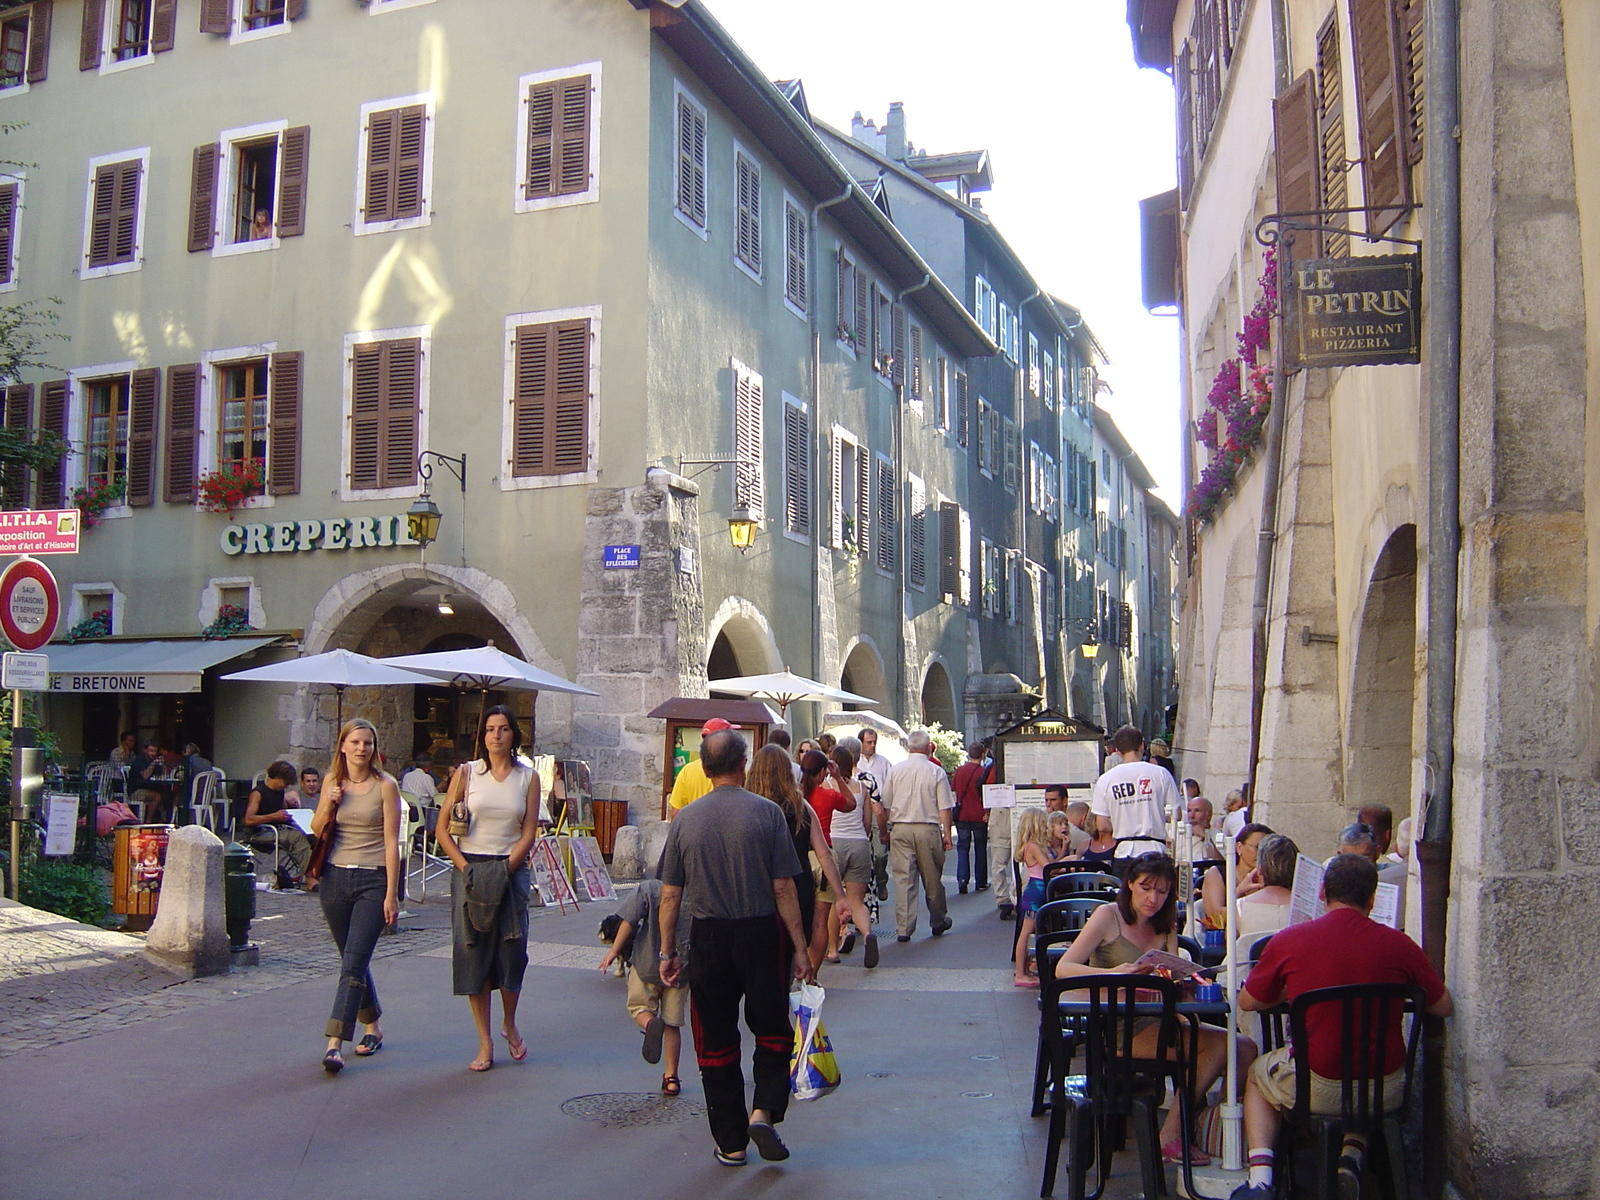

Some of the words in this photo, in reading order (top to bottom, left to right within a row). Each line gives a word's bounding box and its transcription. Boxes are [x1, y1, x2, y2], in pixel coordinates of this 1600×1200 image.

[1297, 269, 1335, 290] LE
[1306, 289, 1412, 316] PETRIN
[1311, 323, 1404, 338] RESTAURANT
[1325, 337, 1390, 350] PIZZERIA
[35, 542, 42, 550] et
[43, 541, 75, 550] d'Histoire
[13, 595, 44, 605] LIVRAISONS
[20, 606, 45, 615] SERVICES
[17, 615, 39, 624] PUBLICS
[73, 676, 146, 690] BRETONNE
[1020, 725, 1035, 735] LE
[1039, 725, 1077, 736] PETRIN
[1111, 782, 1136, 800] RED
[1139, 778, 1153, 795] Z
